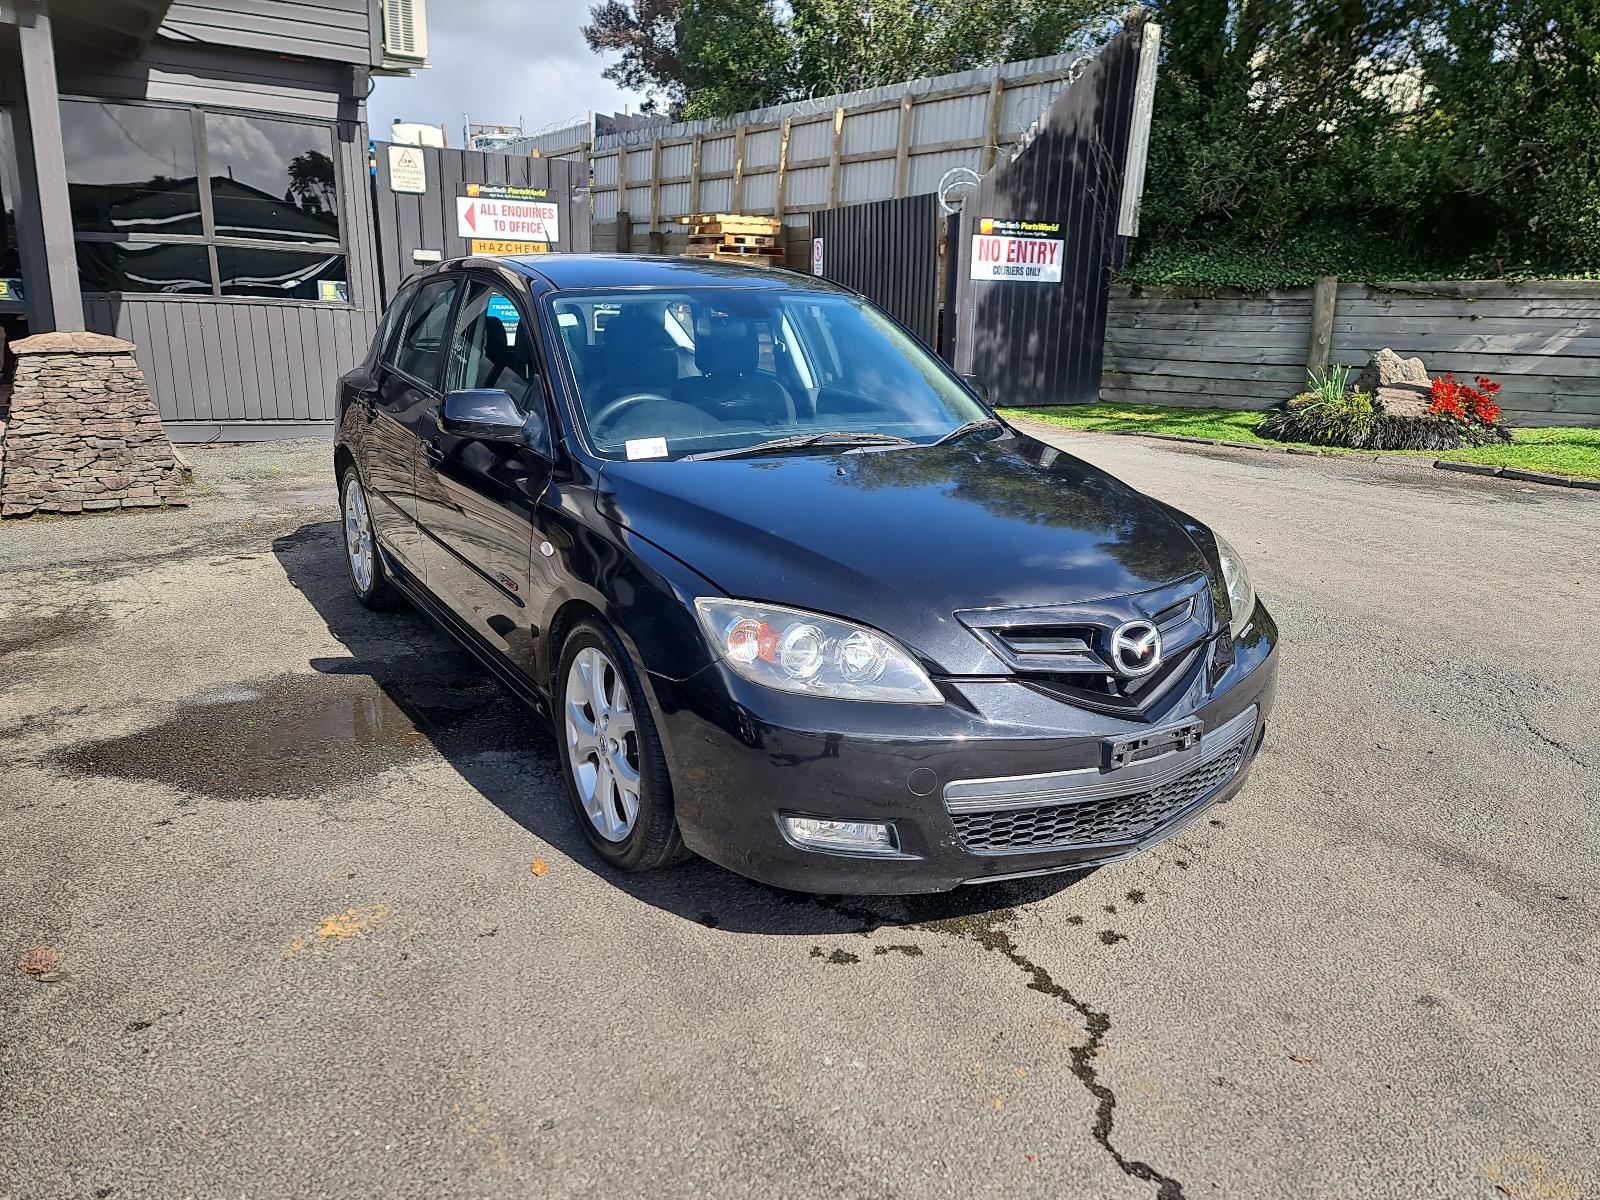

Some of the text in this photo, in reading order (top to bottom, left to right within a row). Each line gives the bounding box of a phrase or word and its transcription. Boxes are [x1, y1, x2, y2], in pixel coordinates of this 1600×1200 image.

[507, 187, 546, 197] PartsWorld
[480, 203, 554, 219] ALL ENQUIRIES
[494, 220, 542, 233] TO OFFICE
[1021, 222, 1059, 232] PartsWorld
[479, 242, 540, 253] HAZCHEM
[979, 238, 1058, 265] NO ENTRY
[993, 266, 1041, 276] COURIERS ONLY
